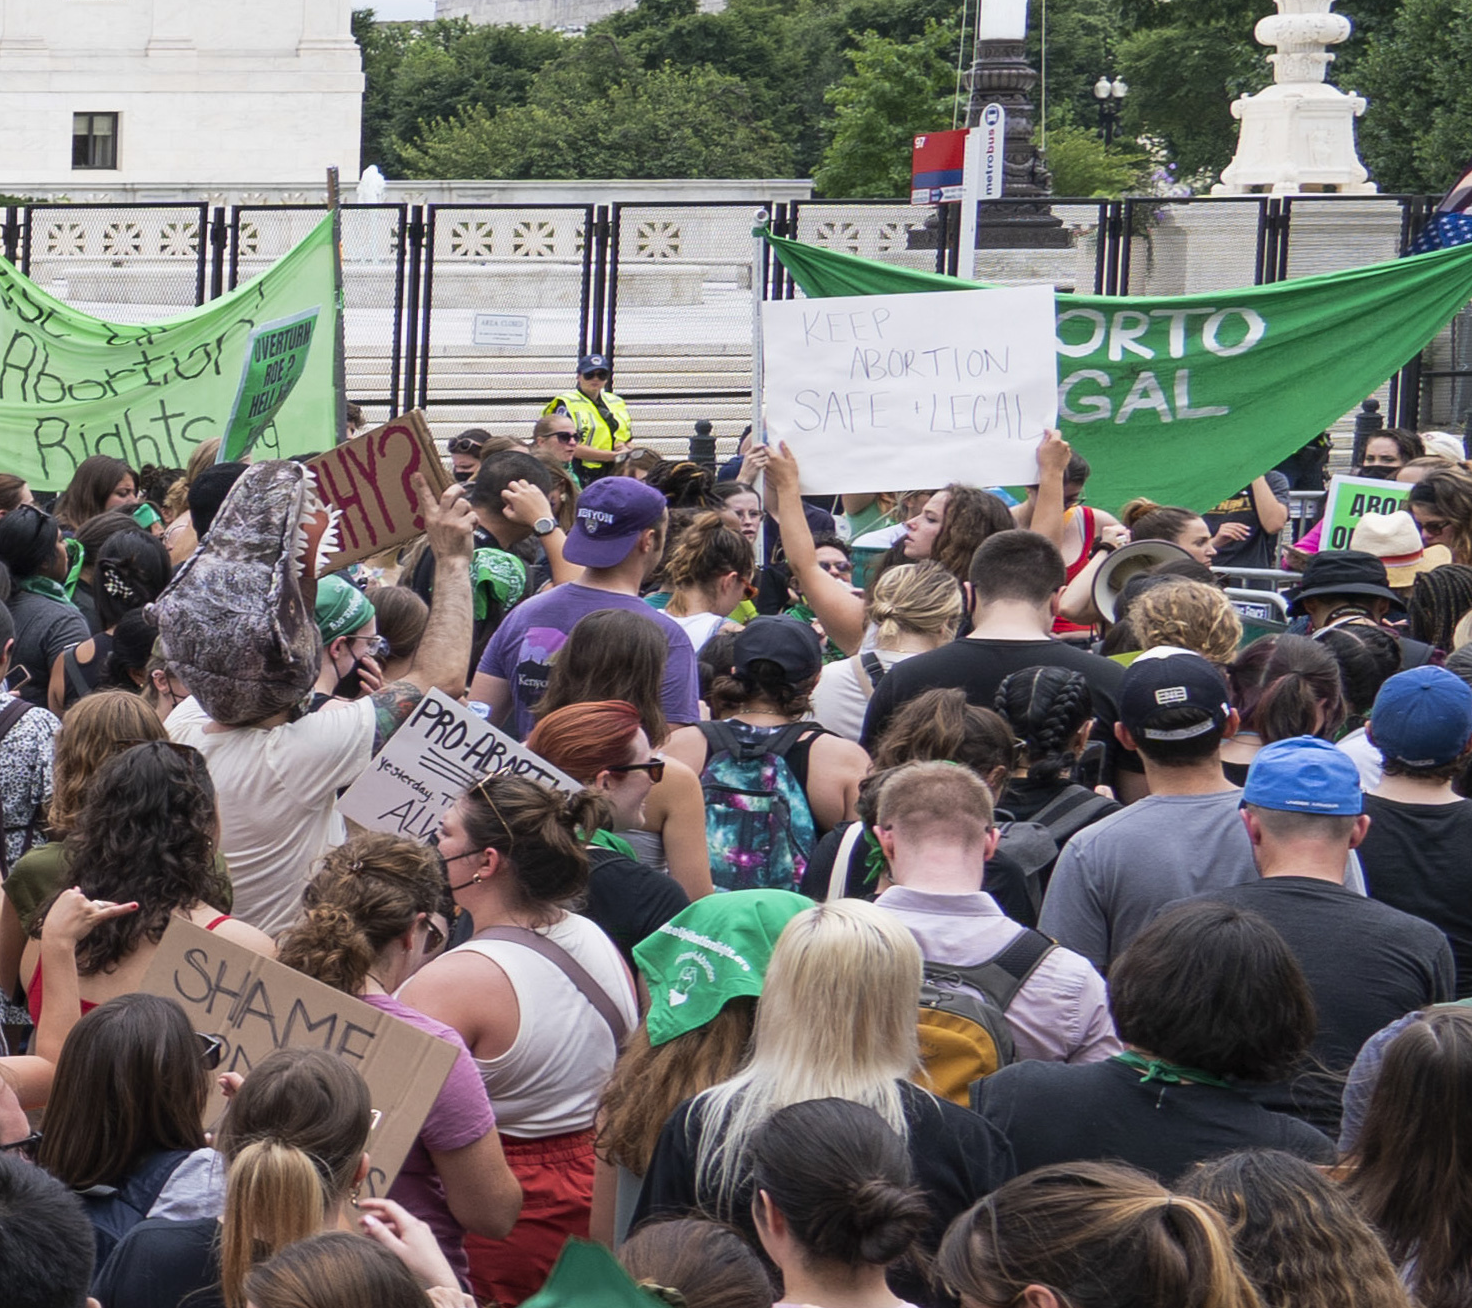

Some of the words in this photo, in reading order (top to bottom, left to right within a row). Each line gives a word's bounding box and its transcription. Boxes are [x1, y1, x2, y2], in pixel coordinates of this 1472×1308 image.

[254, 320, 313, 364] OVERTURN
[482, 319, 498, 327] AREA
[500, 320, 523, 328] CLOSED
[803, 307, 891, 347] KEEP
[1055, 307, 1266, 362] ORTO
[0, 318, 254, 404] Abortion
[851, 346, 1010, 383] ABORTION
[794, 389, 892, 433] SAFE
[929, 391, 1048, 441] LEGAL
[1058, 369, 1230, 424] GAL
[518, 675, 549, 691] Kenyo
[174, 948, 376, 1059] SHAME
